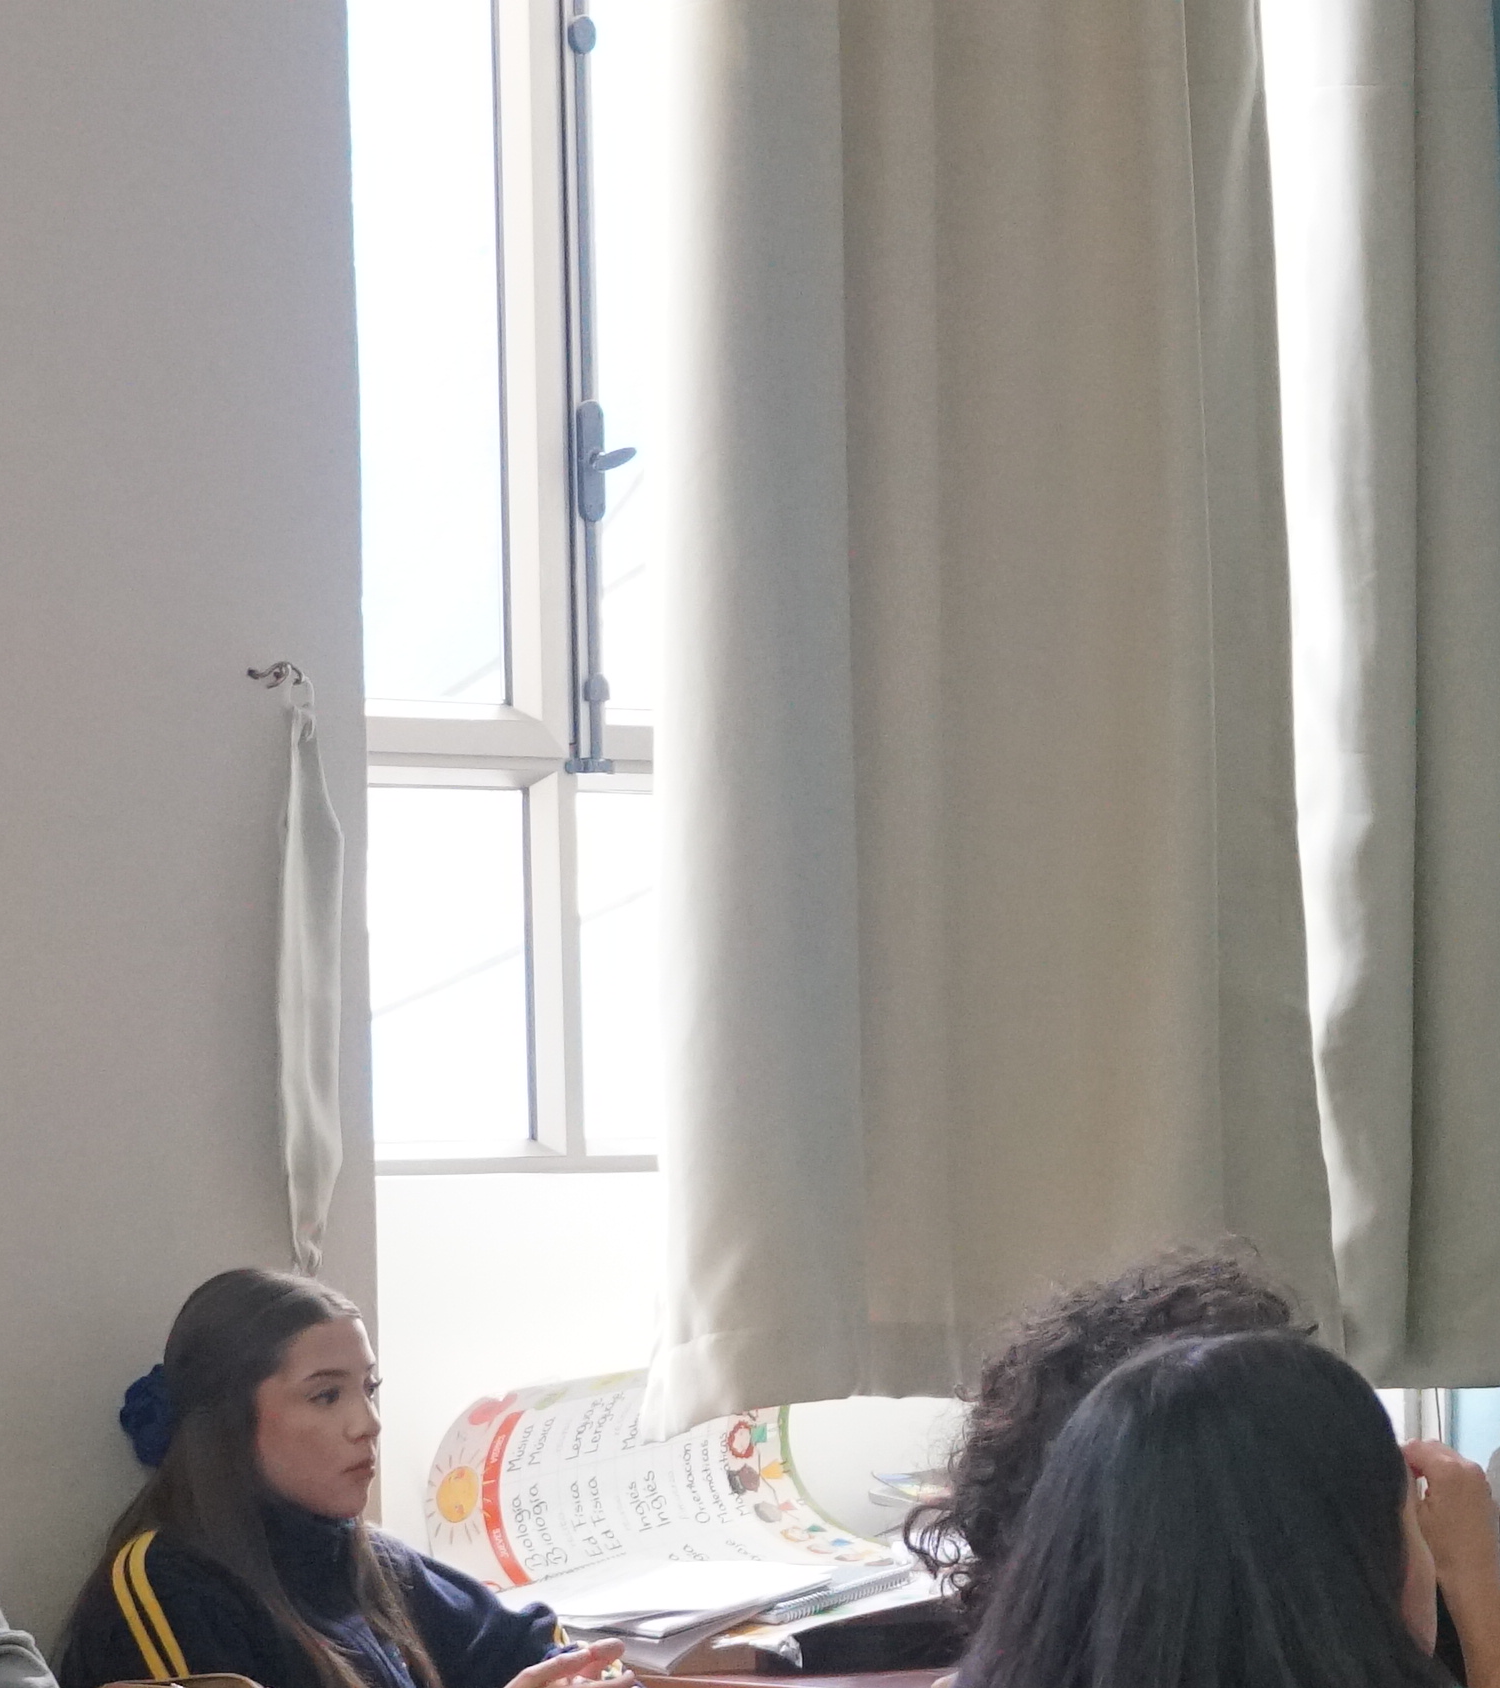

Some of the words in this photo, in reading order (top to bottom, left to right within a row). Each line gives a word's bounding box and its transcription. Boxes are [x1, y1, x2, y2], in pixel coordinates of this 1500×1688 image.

[506, 1424, 534, 1473] Música
[528, 1416, 556, 1466] Música
[569, 1480, 587, 1534] Física
[587, 1475, 607, 1527] Física
[628, 1480, 653, 1533] Inglés
[643, 1469, 672, 1528] Inglés
[682, 1441, 712, 1525] Orientación
[699, 1438, 735, 1525] Matemáticas
[514, 1495, 547, 1572] Biología
[525, 1482, 569, 1566] Biología
